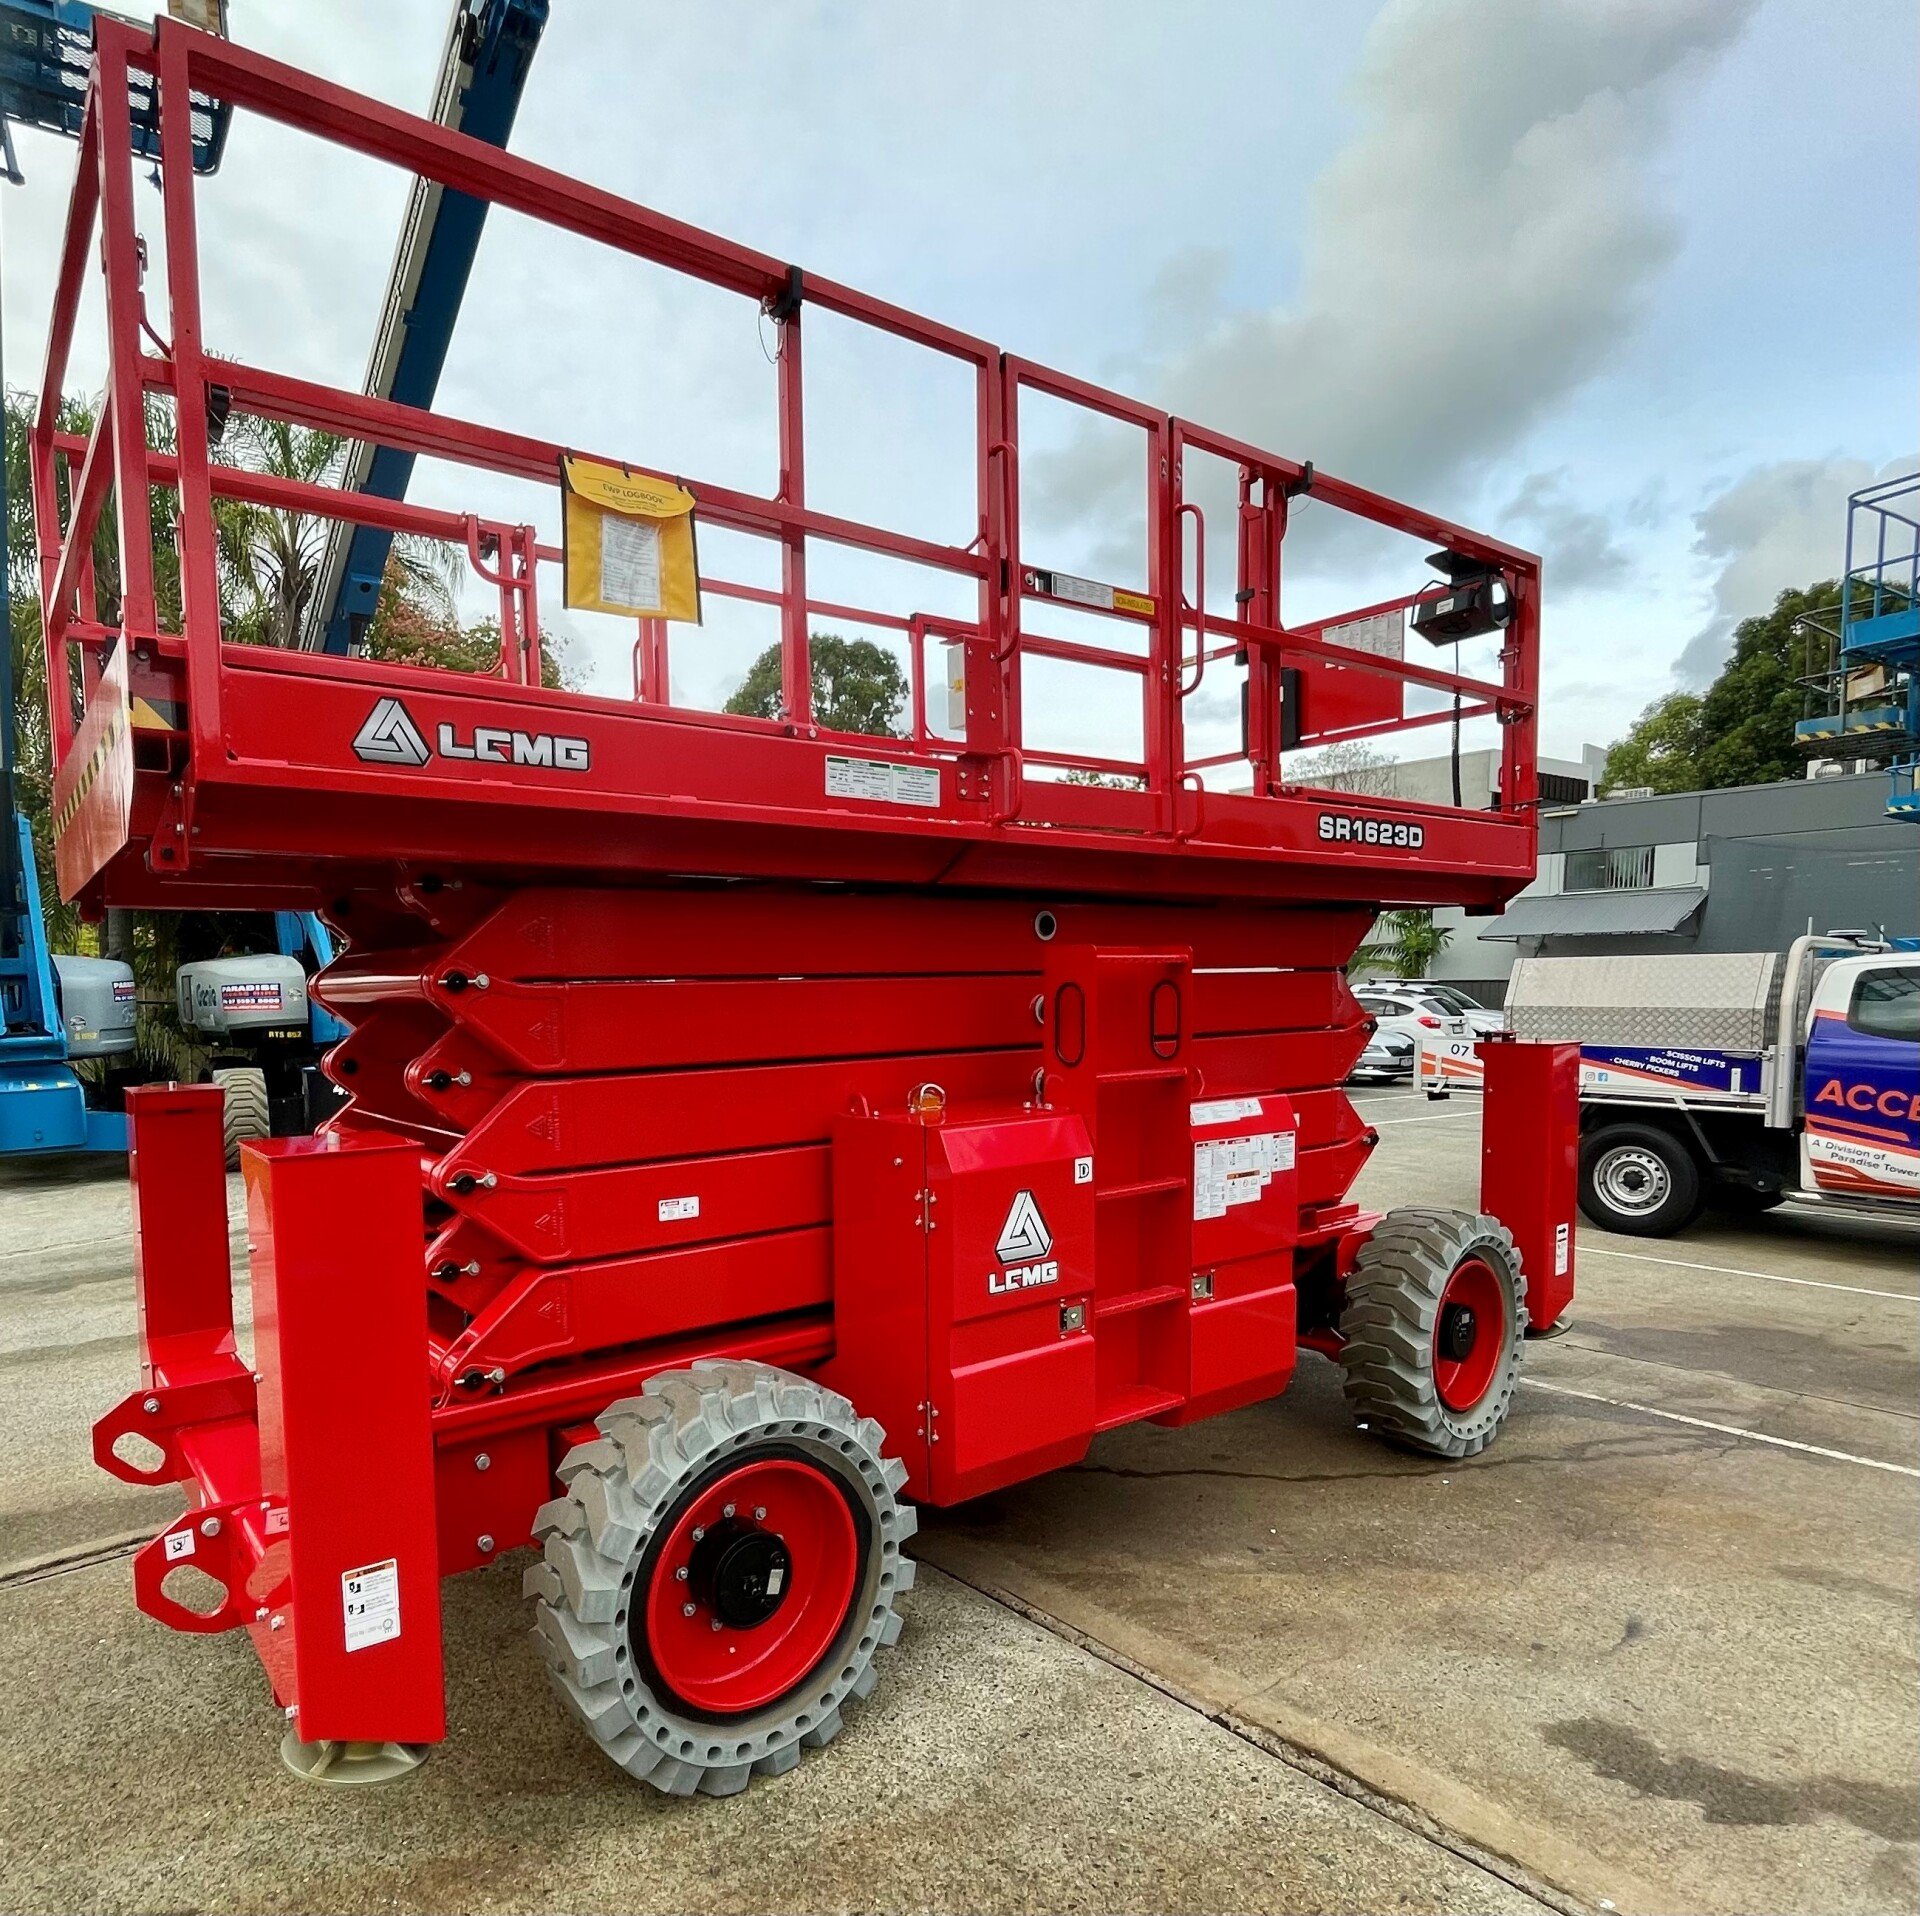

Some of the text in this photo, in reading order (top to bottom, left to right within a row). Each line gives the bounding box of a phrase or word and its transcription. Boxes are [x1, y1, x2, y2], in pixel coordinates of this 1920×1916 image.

[623, 488, 664, 505] LOGBOOK
[1319, 815, 1423, 848] SR1623D
[222, 984, 279, 992] PARADISE
[1450, 1043, 1470, 1057] 07
[1613, 1057, 1680, 1077] CHERRY PICKERS
[1649, 1055, 1699, 1072] BOOM LIFTS
[1666, 1050, 1726, 1069] SCISSOR LIFTS
[1812, 1139, 1887, 1161] A Division of
[1077, 1162, 1090, 1179] D
[1830, 1152, 1920, 1177] Paradise Tower
